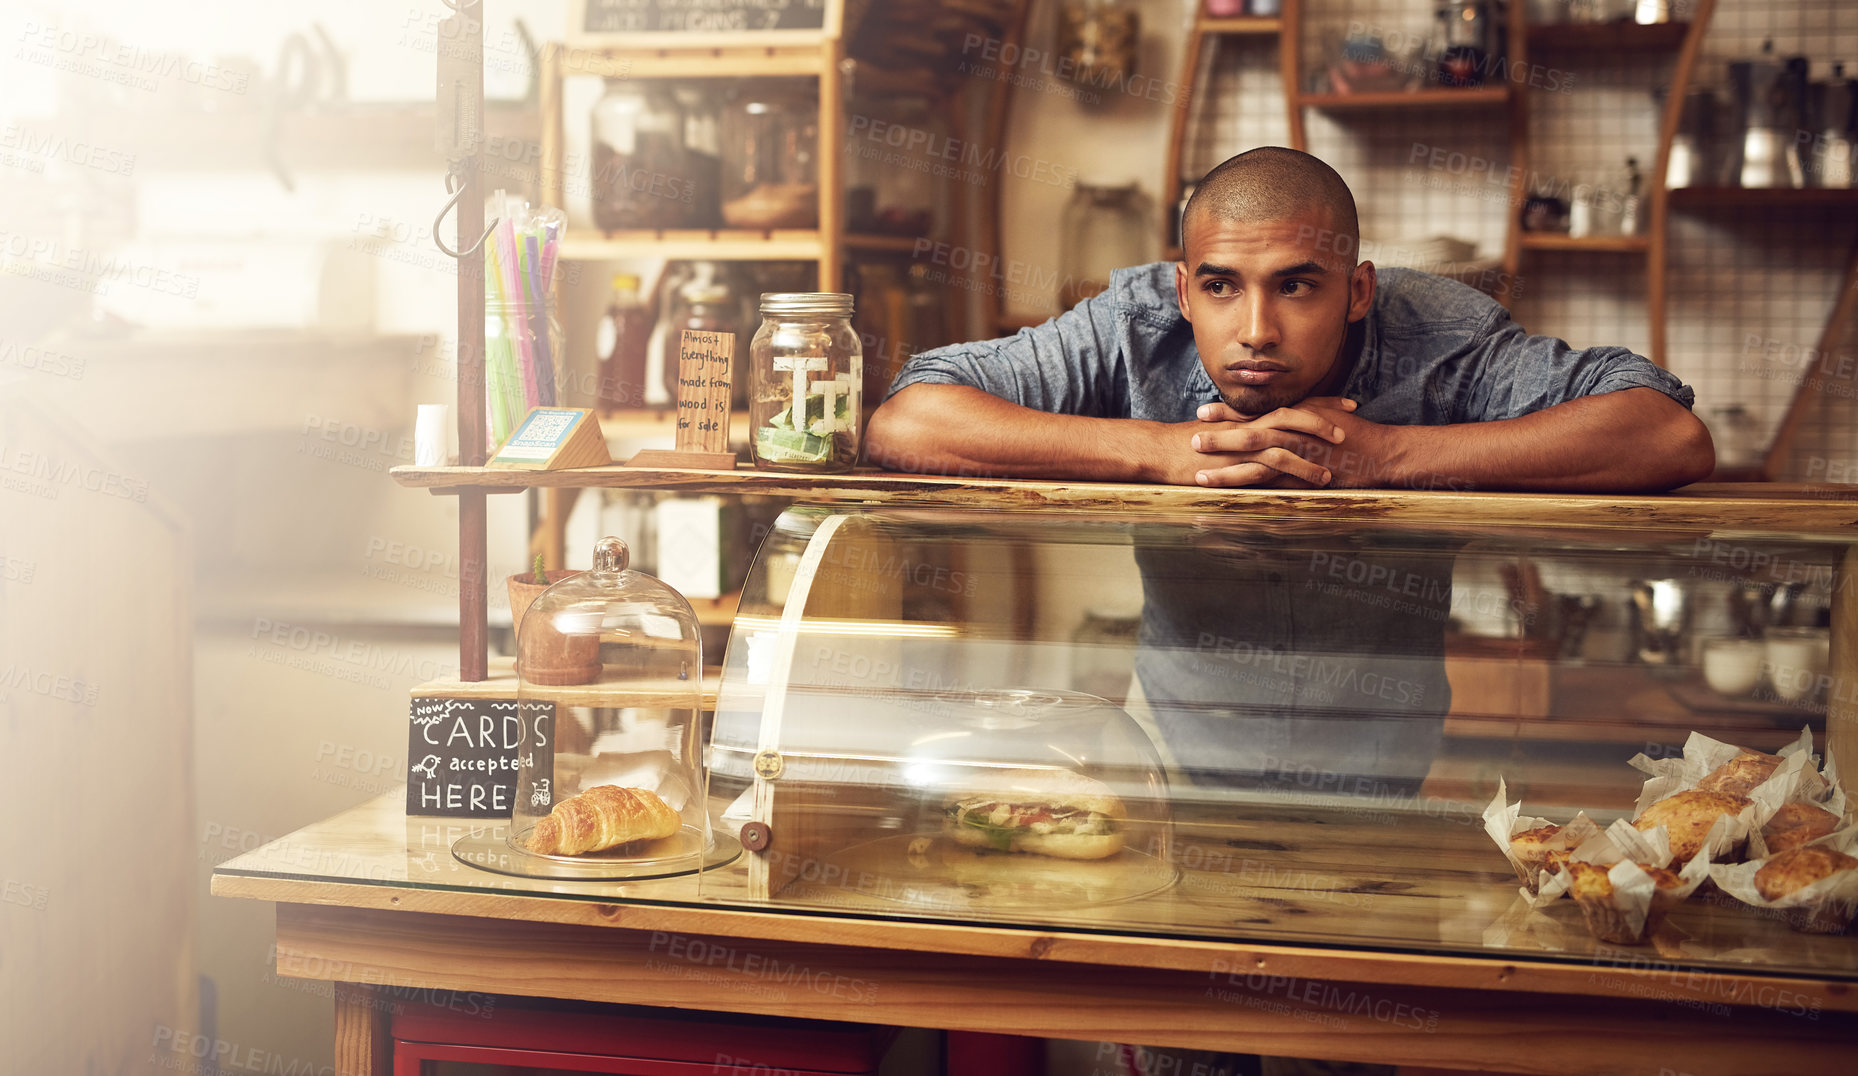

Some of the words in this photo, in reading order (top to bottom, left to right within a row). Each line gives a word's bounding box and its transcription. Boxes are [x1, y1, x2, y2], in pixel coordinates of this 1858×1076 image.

[683, 331, 719, 345] Almost
[681, 347, 729, 375] Everything
[680, 376, 706, 387] made
[709, 376, 731, 389] from
[679, 398, 707, 410] wood
[715, 399, 724, 412] is
[678, 418, 691, 429] for
[698, 418, 718, 431] sale
[417, 704, 443, 715] NOW
[423, 715, 549, 750] CARDS
[450, 753, 533, 775] accepted
[422, 782, 507, 810] HERE
